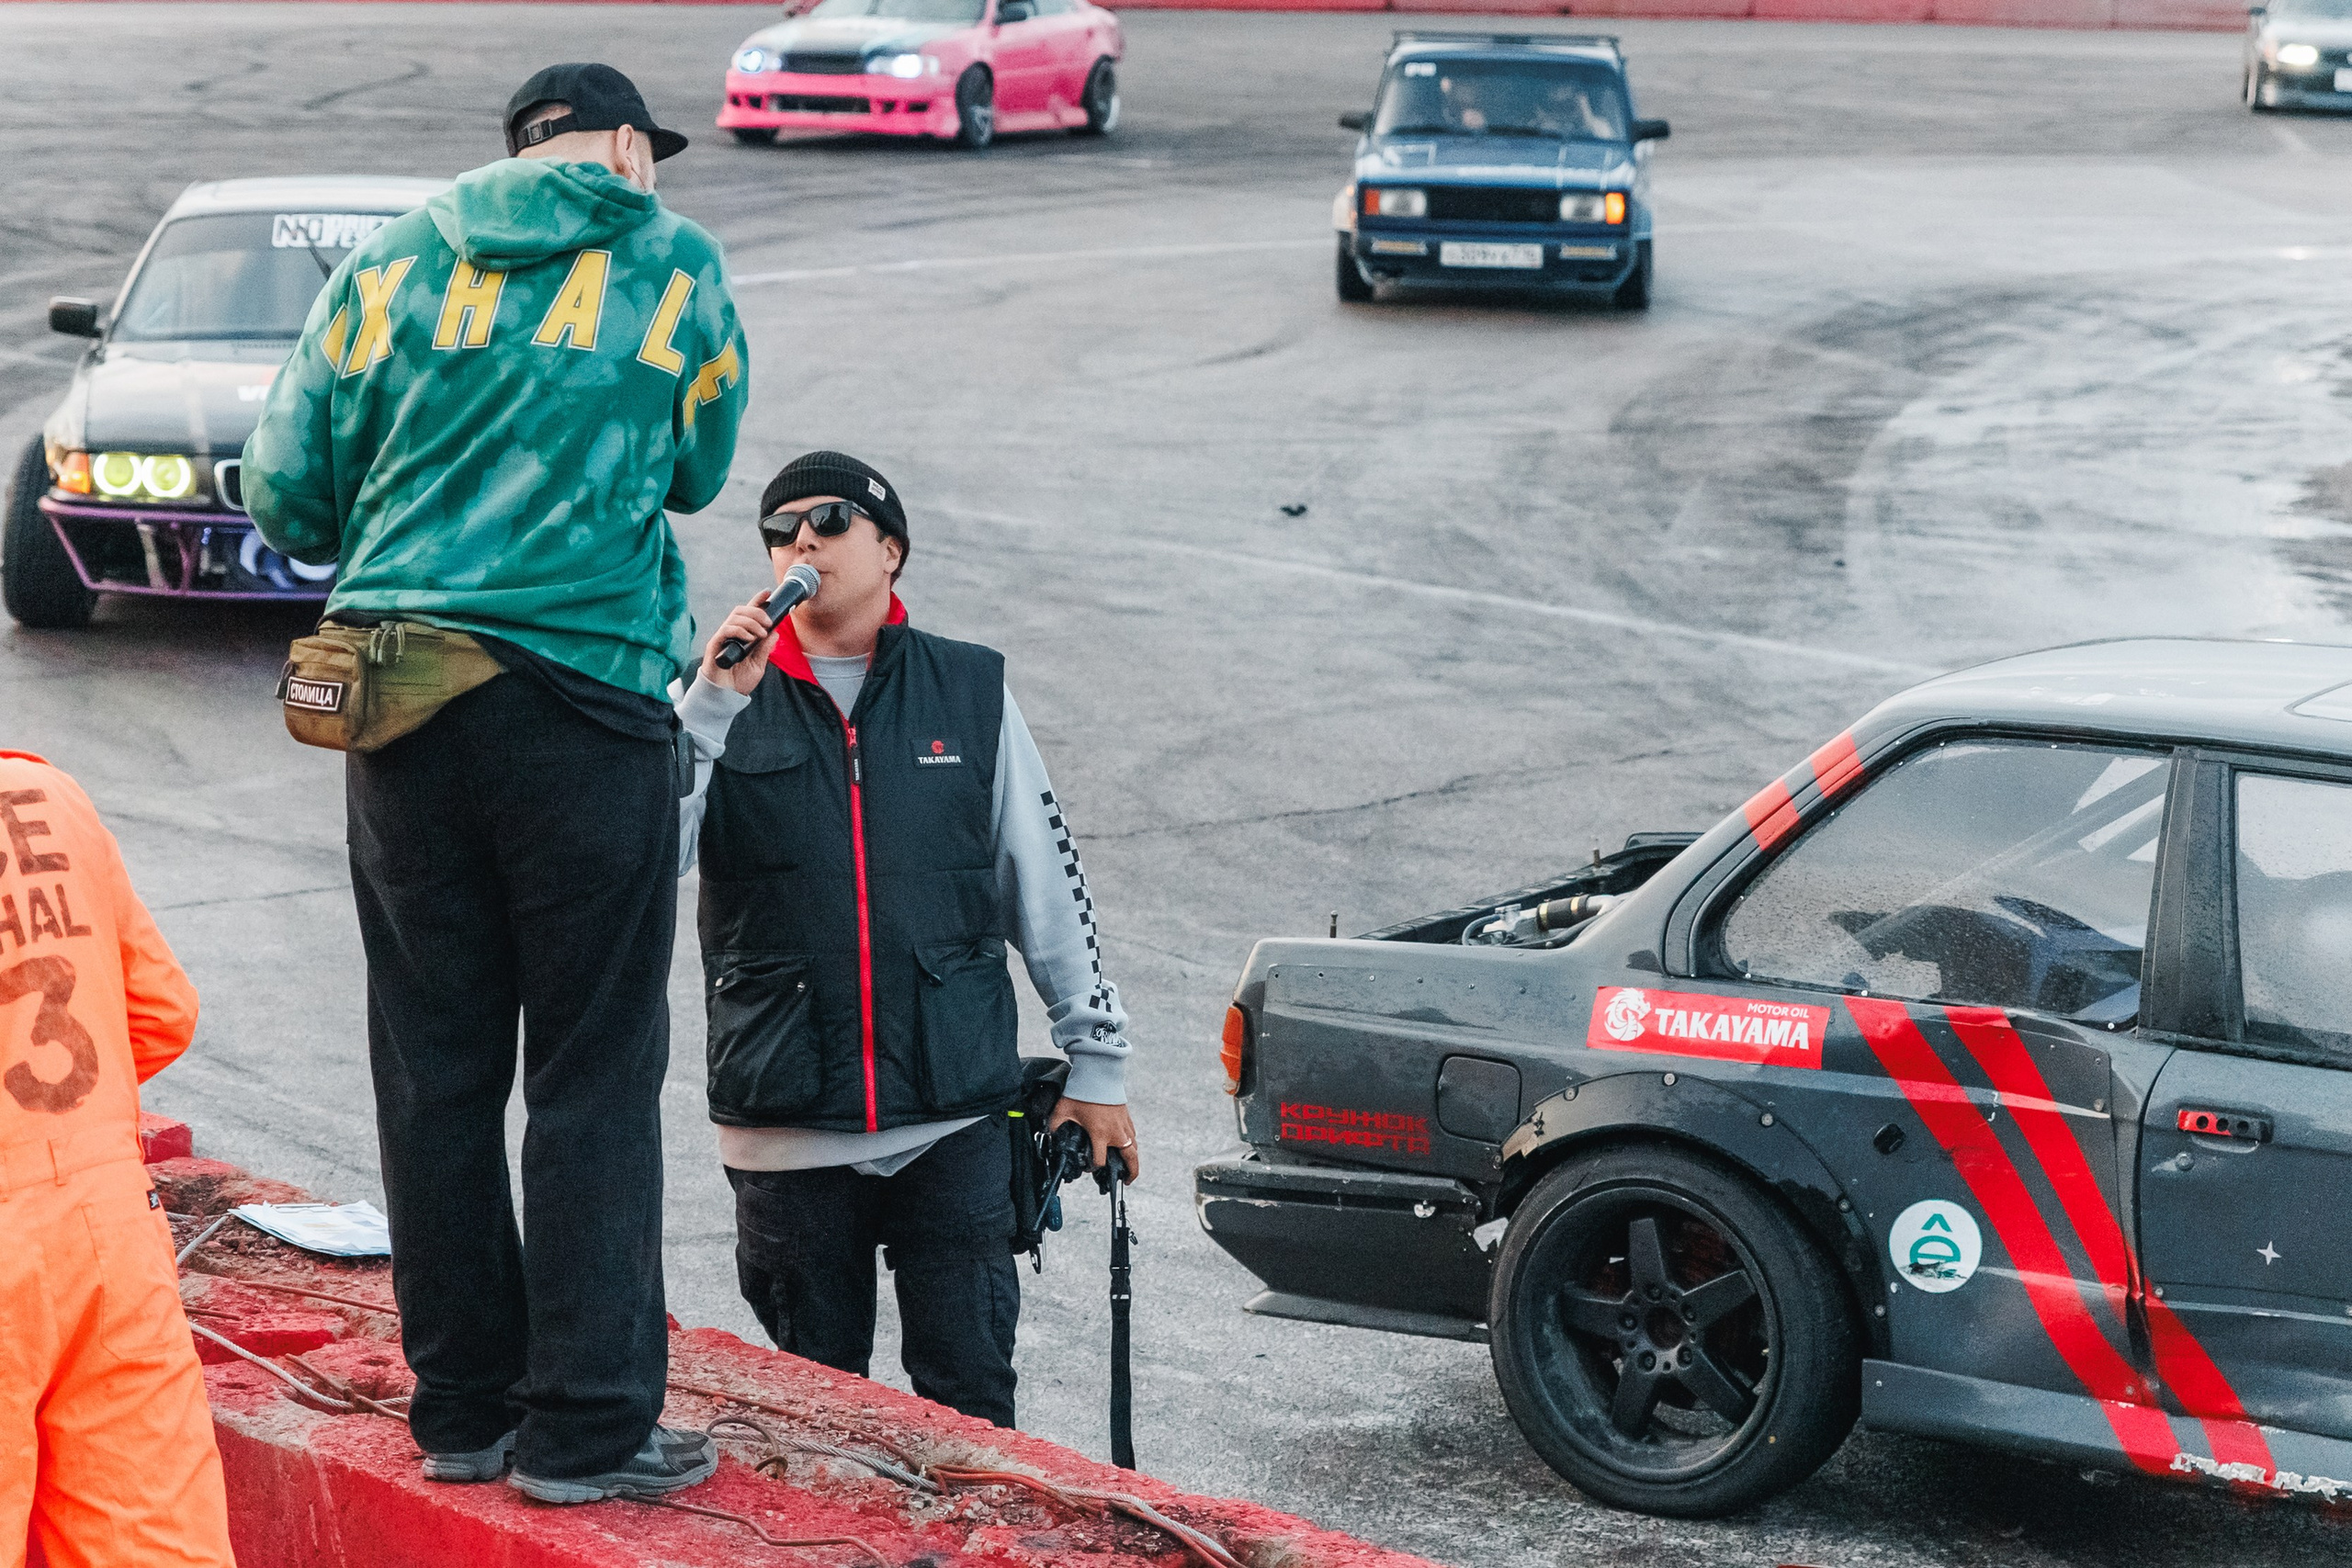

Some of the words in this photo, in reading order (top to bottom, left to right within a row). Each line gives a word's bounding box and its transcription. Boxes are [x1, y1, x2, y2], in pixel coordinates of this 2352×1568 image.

[290, 682, 333, 706] СТОЛИЦА
[918, 755, 962, 764] TAKAYAMA
[1747, 1003, 1788, 1016] MOTOR
[1791, 1008, 1809, 1018] OIL
[1655, 1010, 1810, 1050] TAKAYAMA
[1281, 1101, 1429, 1134] КРУЖОК
[1282, 1122, 1430, 1156] ДРИФТА
